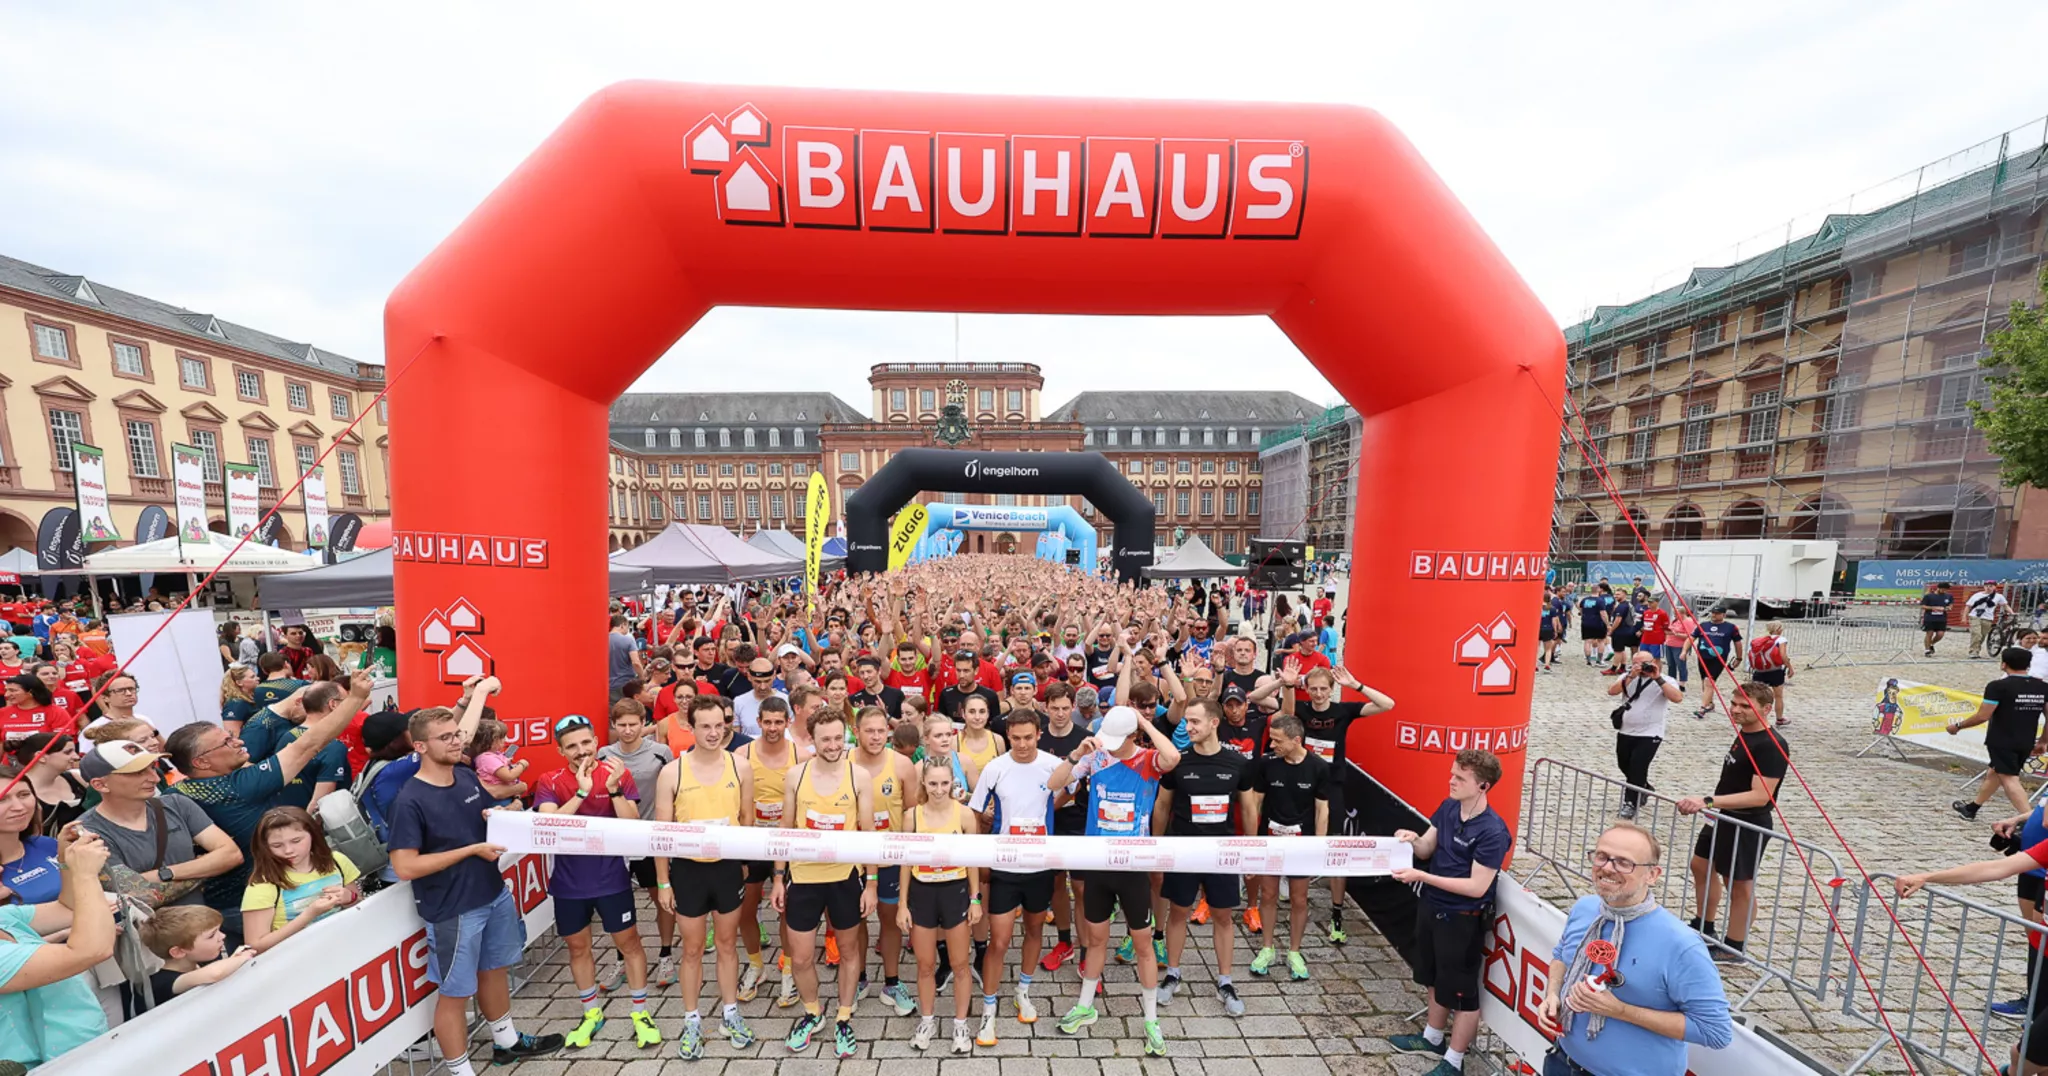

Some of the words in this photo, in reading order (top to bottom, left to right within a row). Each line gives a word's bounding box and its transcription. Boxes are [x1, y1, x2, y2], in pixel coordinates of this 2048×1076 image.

[797, 141, 1295, 221] BAUHAUS
[983, 466, 1039, 477] engelhorn
[972, 510, 1046, 521] VeniceBeach
[894, 509, 925, 554] ZÜGIG
[392, 536, 546, 564] BAUHAUS
[1895, 569, 1921, 577] MBS
[1924, 568, 1955, 580] Study
[534, 837, 557, 846] LAUF
[650, 843, 674, 852] LAUF
[768, 847, 789, 857] LAUF
[883, 851, 904, 860] LAUF
[996, 853, 1018, 863] LAUF
[1108, 855, 1130, 865] LAUF
[1218, 857, 1240, 866] LAUF
[1326, 858, 1347, 867] LAUF
